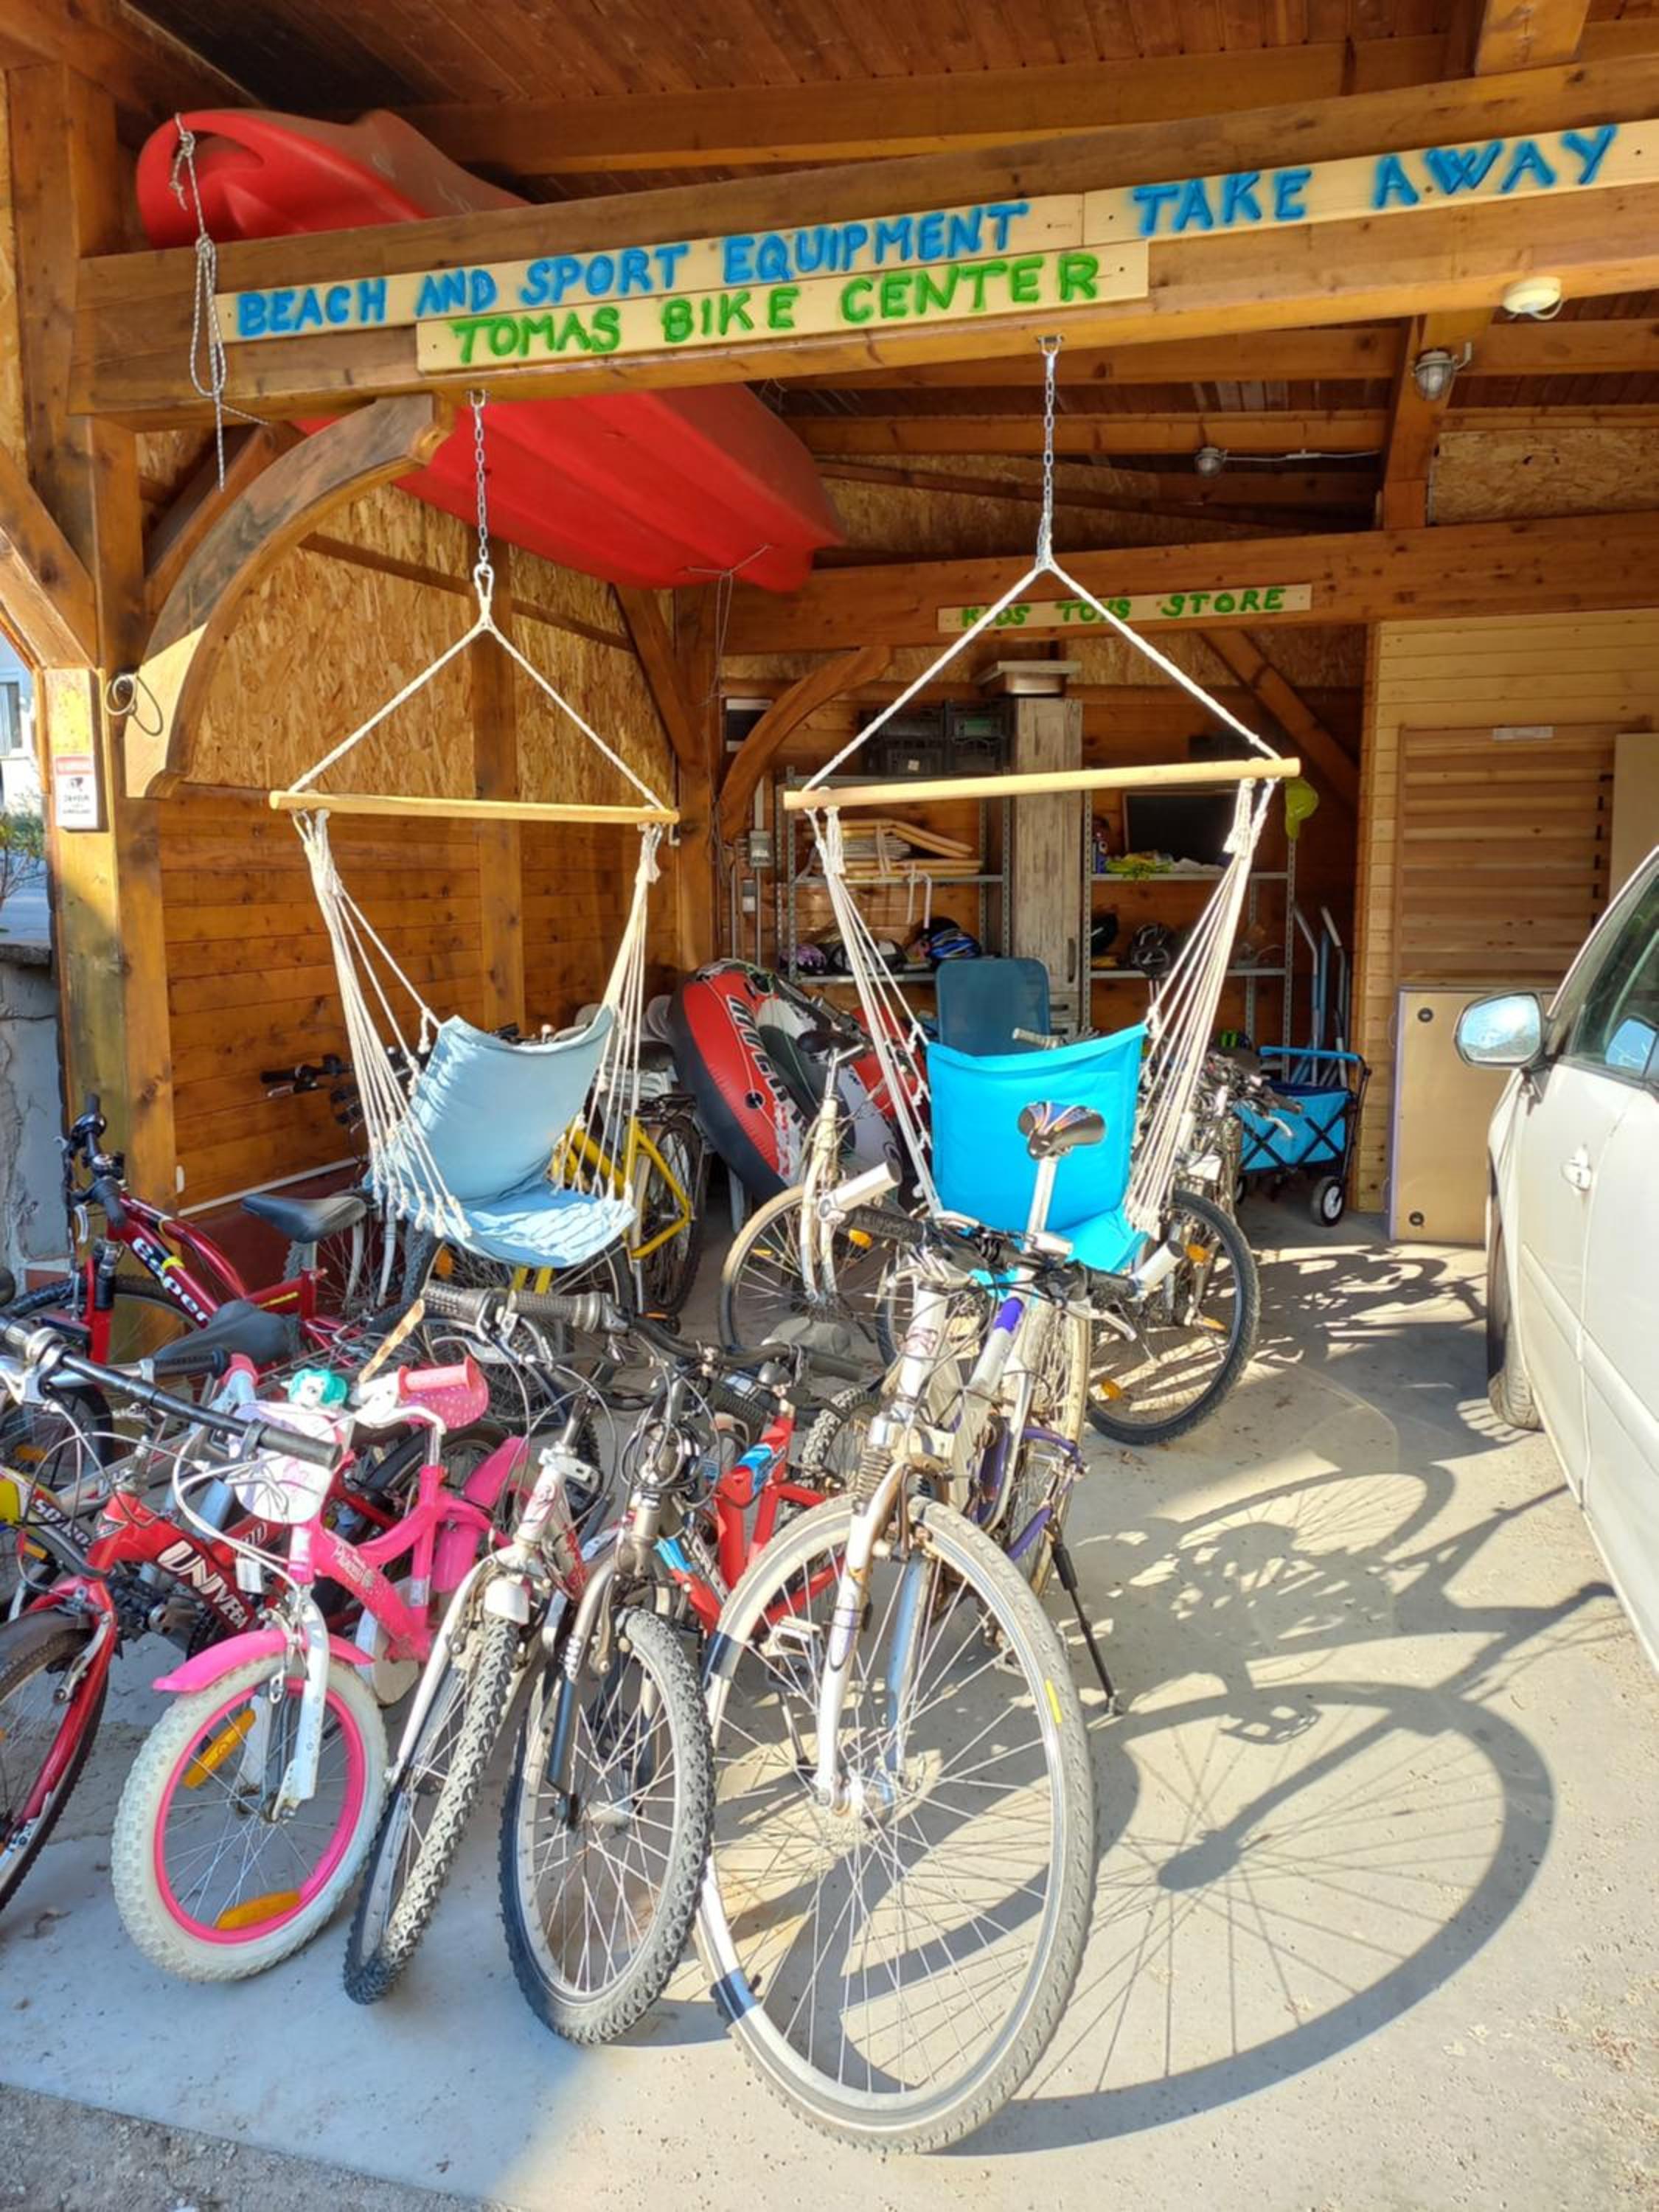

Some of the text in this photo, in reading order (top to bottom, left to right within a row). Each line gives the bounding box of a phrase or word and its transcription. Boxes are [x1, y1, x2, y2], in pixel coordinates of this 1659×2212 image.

[237, 124, 1617, 338] BEACH AND SPORT EQUIPMENT TAKE AWAY
[447, 253, 1099, 364] TOMAS BIKE CENTER
[1161, 587, 1286, 618] STORE
